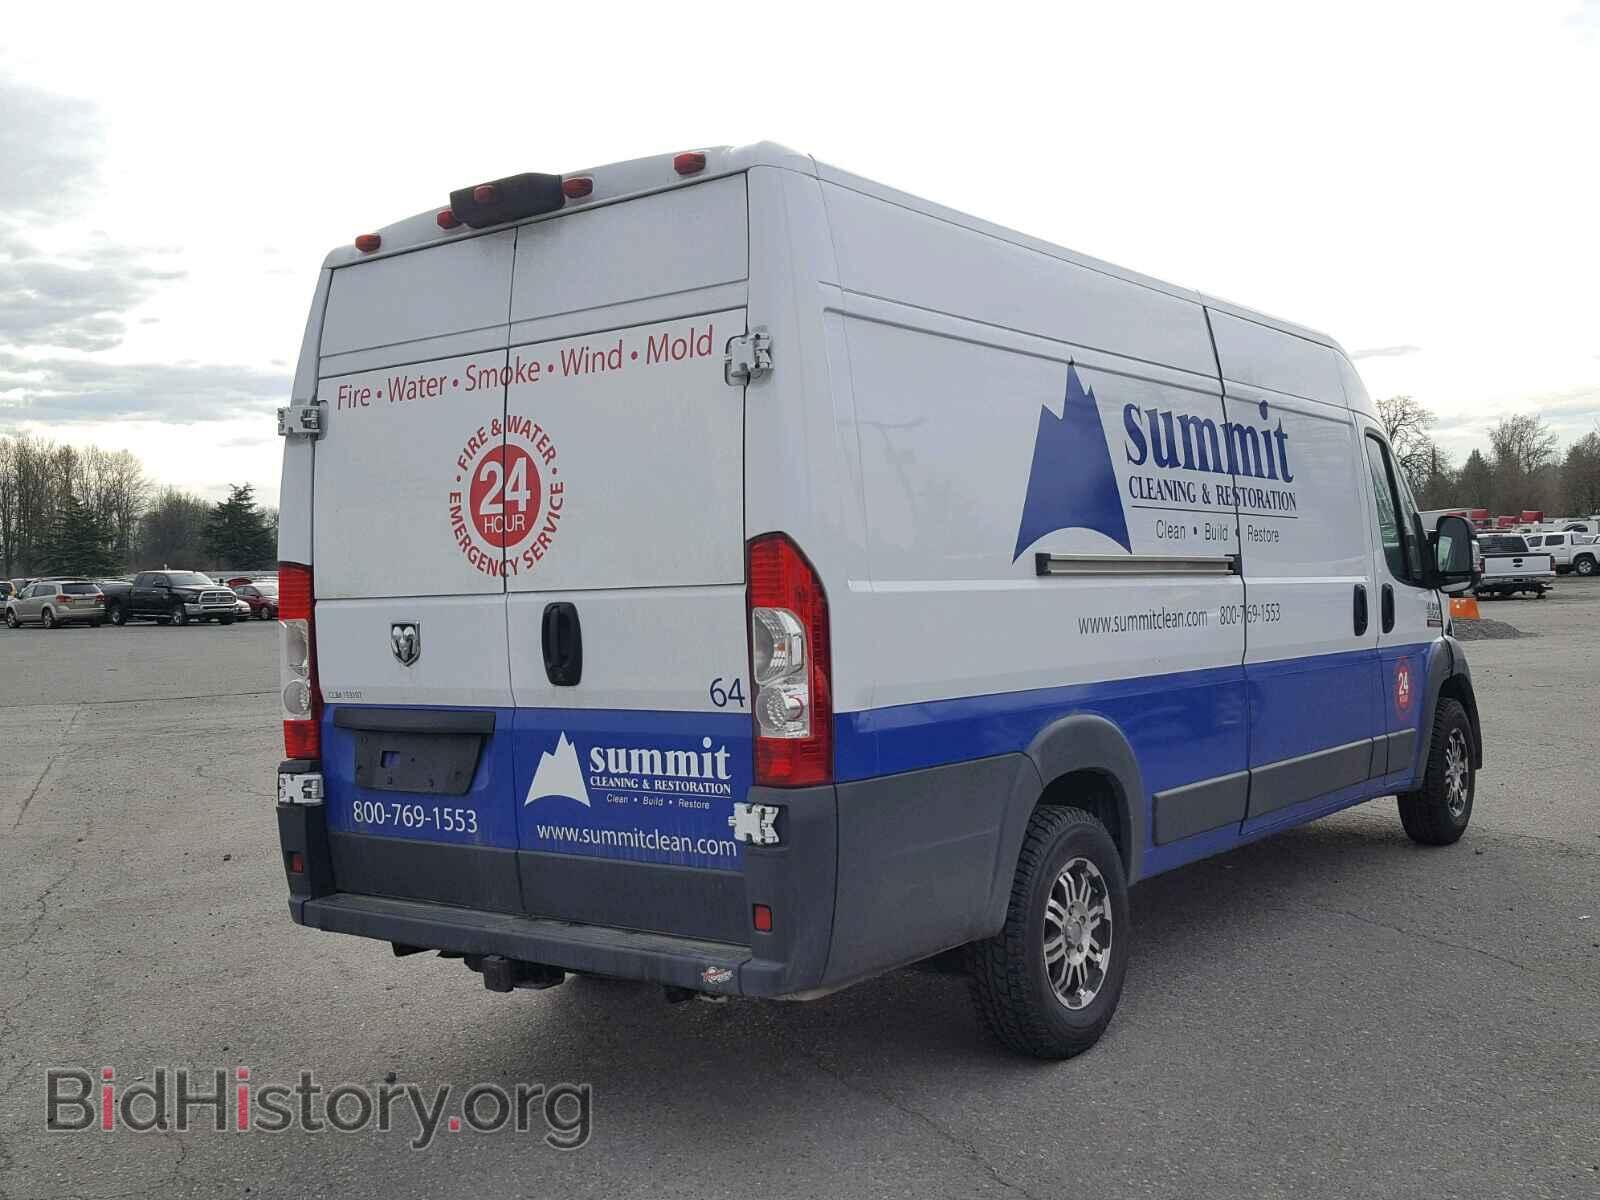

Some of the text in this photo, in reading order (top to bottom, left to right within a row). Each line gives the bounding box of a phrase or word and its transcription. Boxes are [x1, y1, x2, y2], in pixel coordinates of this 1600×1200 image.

[338, 324, 713, 410] Fire Water Smoke Wind Mold
[457, 415, 557, 471] FIRE & WATER
[1123, 400, 1295, 483] summit
[479, 457, 531, 515] 24
[1129, 475, 1297, 511] CLEANING & RESTORATION
[450, 482, 563, 577] EMERGENCY SERVICE
[484, 514, 525, 533] HOUR
[1156, 519, 1280, 543] Clean Build Restore
[1078, 603, 1281, 635] www.summitclean.com 800-769-1553
[710, 678, 745, 707] 64
[1398, 671, 1409, 695] 24
[590, 736, 732, 780] summit
[590, 776, 731, 795] CLEANING & RESTORATION
[353, 801, 478, 833] 800-769-1553
[607, 794, 710, 810] Clean Build Restore
[537, 824, 737, 857] www.summitclean.com
